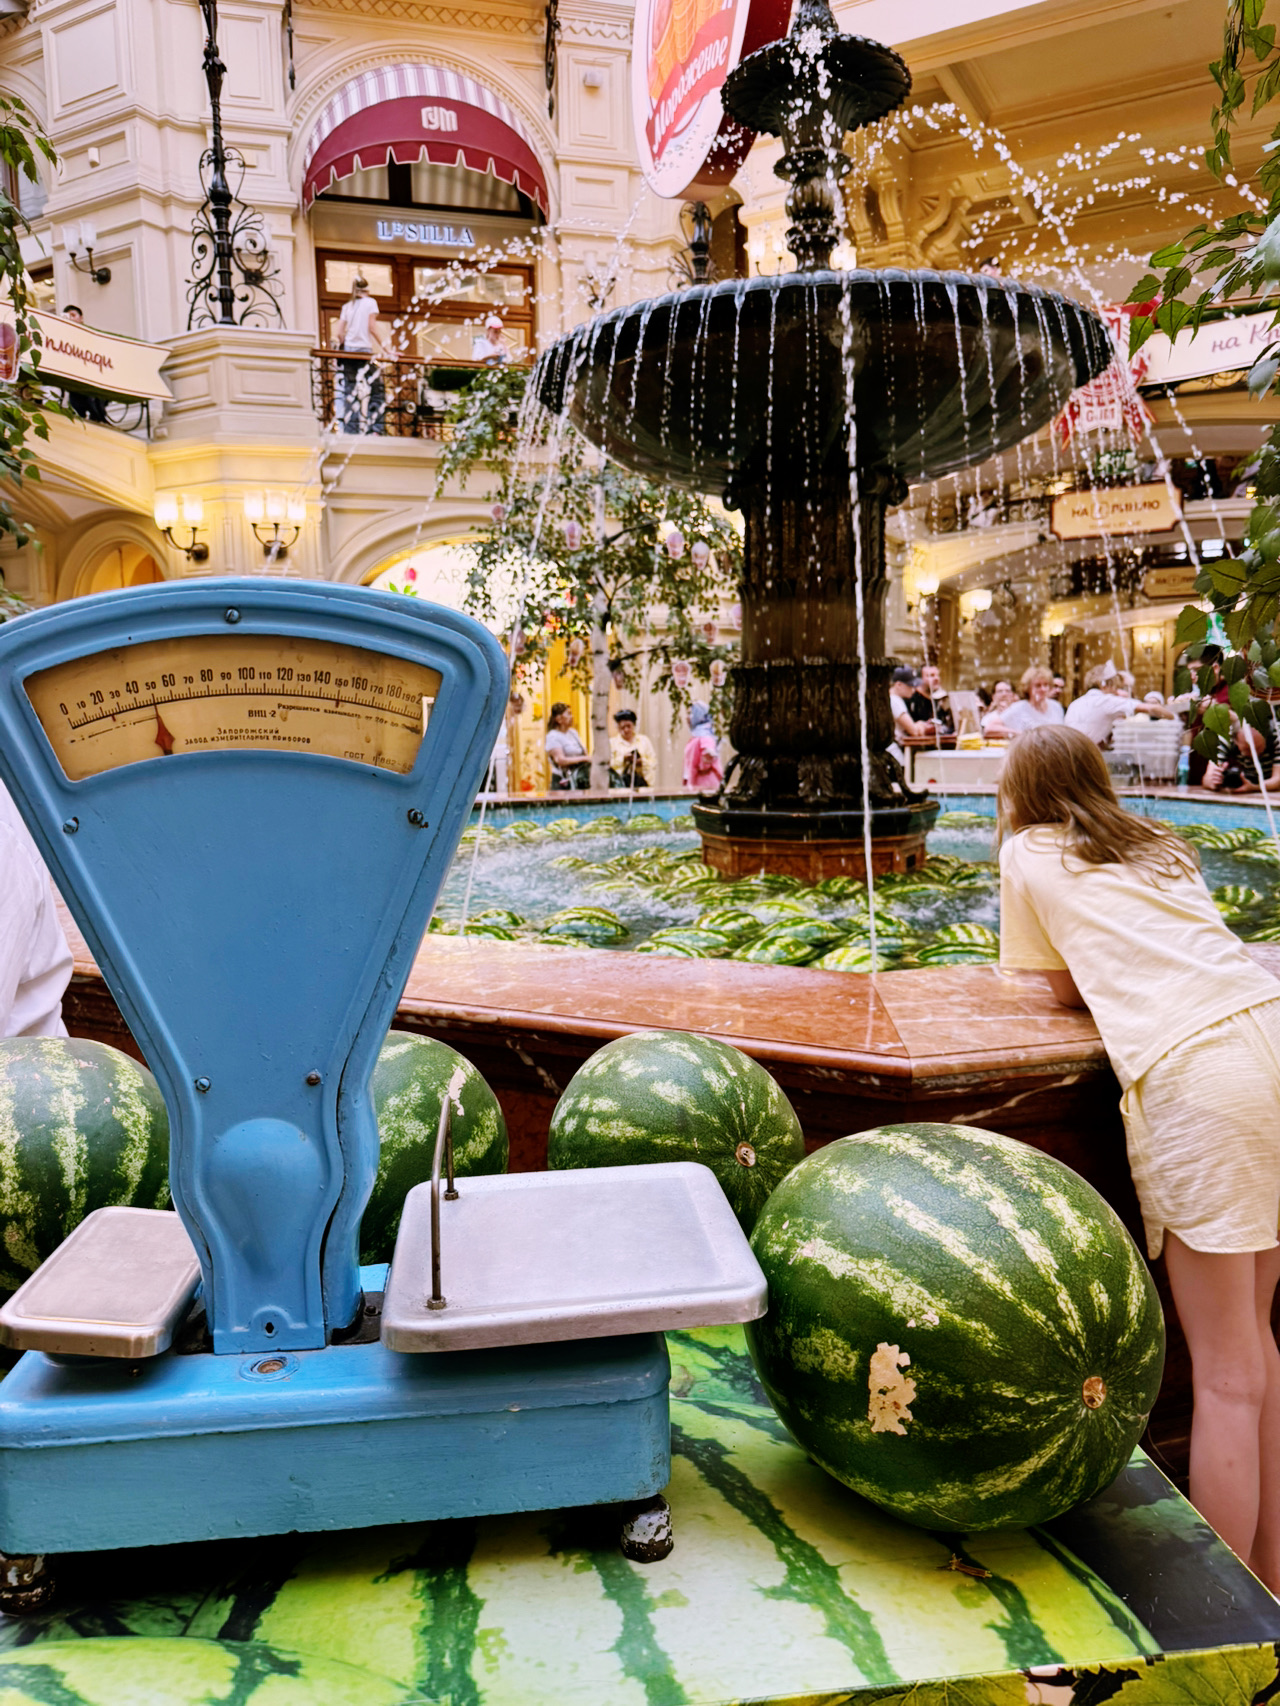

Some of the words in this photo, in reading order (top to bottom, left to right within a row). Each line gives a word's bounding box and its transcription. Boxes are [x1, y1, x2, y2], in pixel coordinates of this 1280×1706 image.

[1212, 336, 1241, 353] на
[46, 335, 114, 373] площади
[60, 703, 69, 715] 0
[77, 701, 86, 709] 10
[90, 690, 104, 705] 20
[109, 690, 120, 699] 30
[125, 680, 139, 694] 40
[145, 681, 156, 690] 50
[162, 673, 176, 687] 60
[183, 676, 194, 684] 70
[200, 669, 213, 682] 80
[220, 672, 231, 681] 90
[238, 667, 255, 680] 100
[259, 672, 272, 680] 110
[277, 667, 294, 681] 120
[297, 673, 311, 682] 130
[313, 670, 331, 685] 140
[334, 677, 349, 687] 150
[351, 676, 368, 691] 160
[370, 685, 384, 695] 170
[386, 684, 403, 699] 180
[402, 693, 416, 703] 190
[185, 736, 208, 745] ЗАВОД
[273, 735, 311, 744] ПРИБОРОВ
[344, 750, 365, 760] ГОСТ
